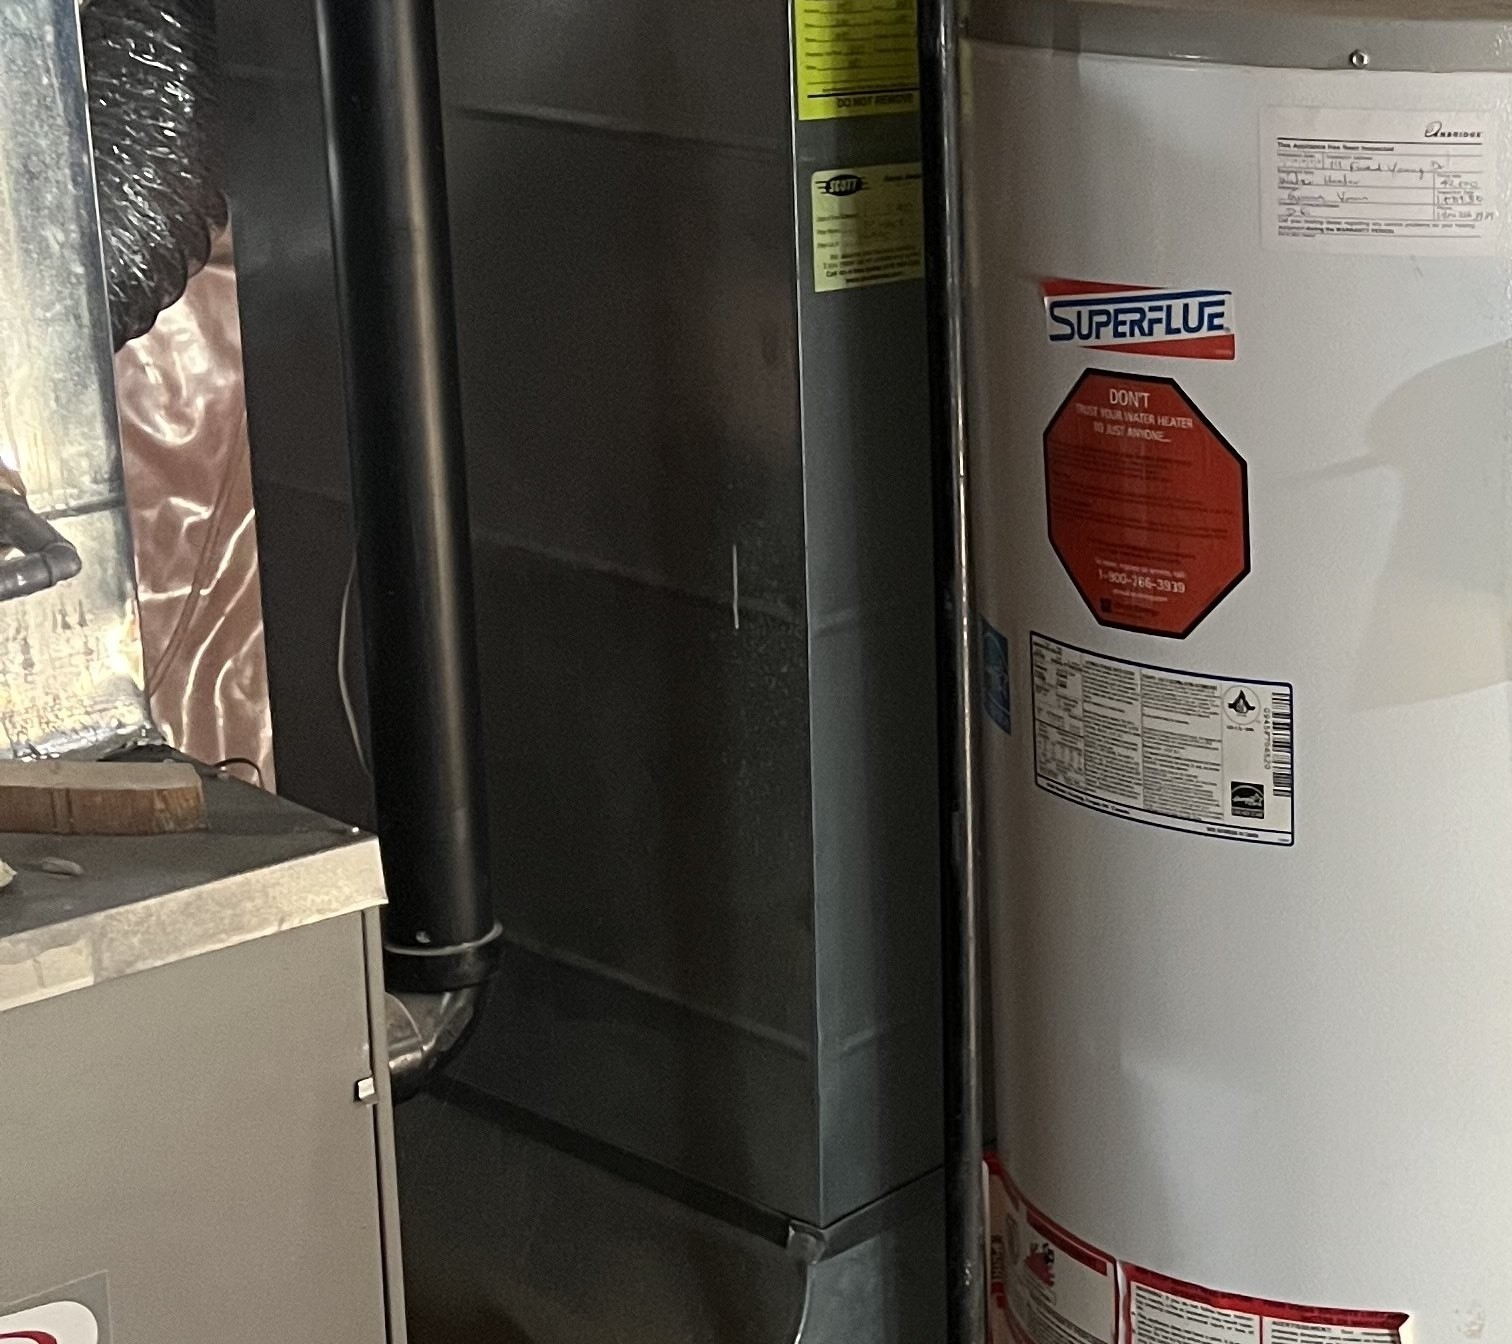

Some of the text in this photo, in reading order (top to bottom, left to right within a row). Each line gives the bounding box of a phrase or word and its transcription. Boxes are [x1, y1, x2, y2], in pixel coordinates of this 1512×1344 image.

[1048, 290, 1232, 342] SUPERFLUE
[1109, 388, 1150, 409] DON'T
[1099, 406, 1123, 422] YOUR
[1123, 409, 1155, 425] WATER
[1157, 416, 1194, 429] HEATER
